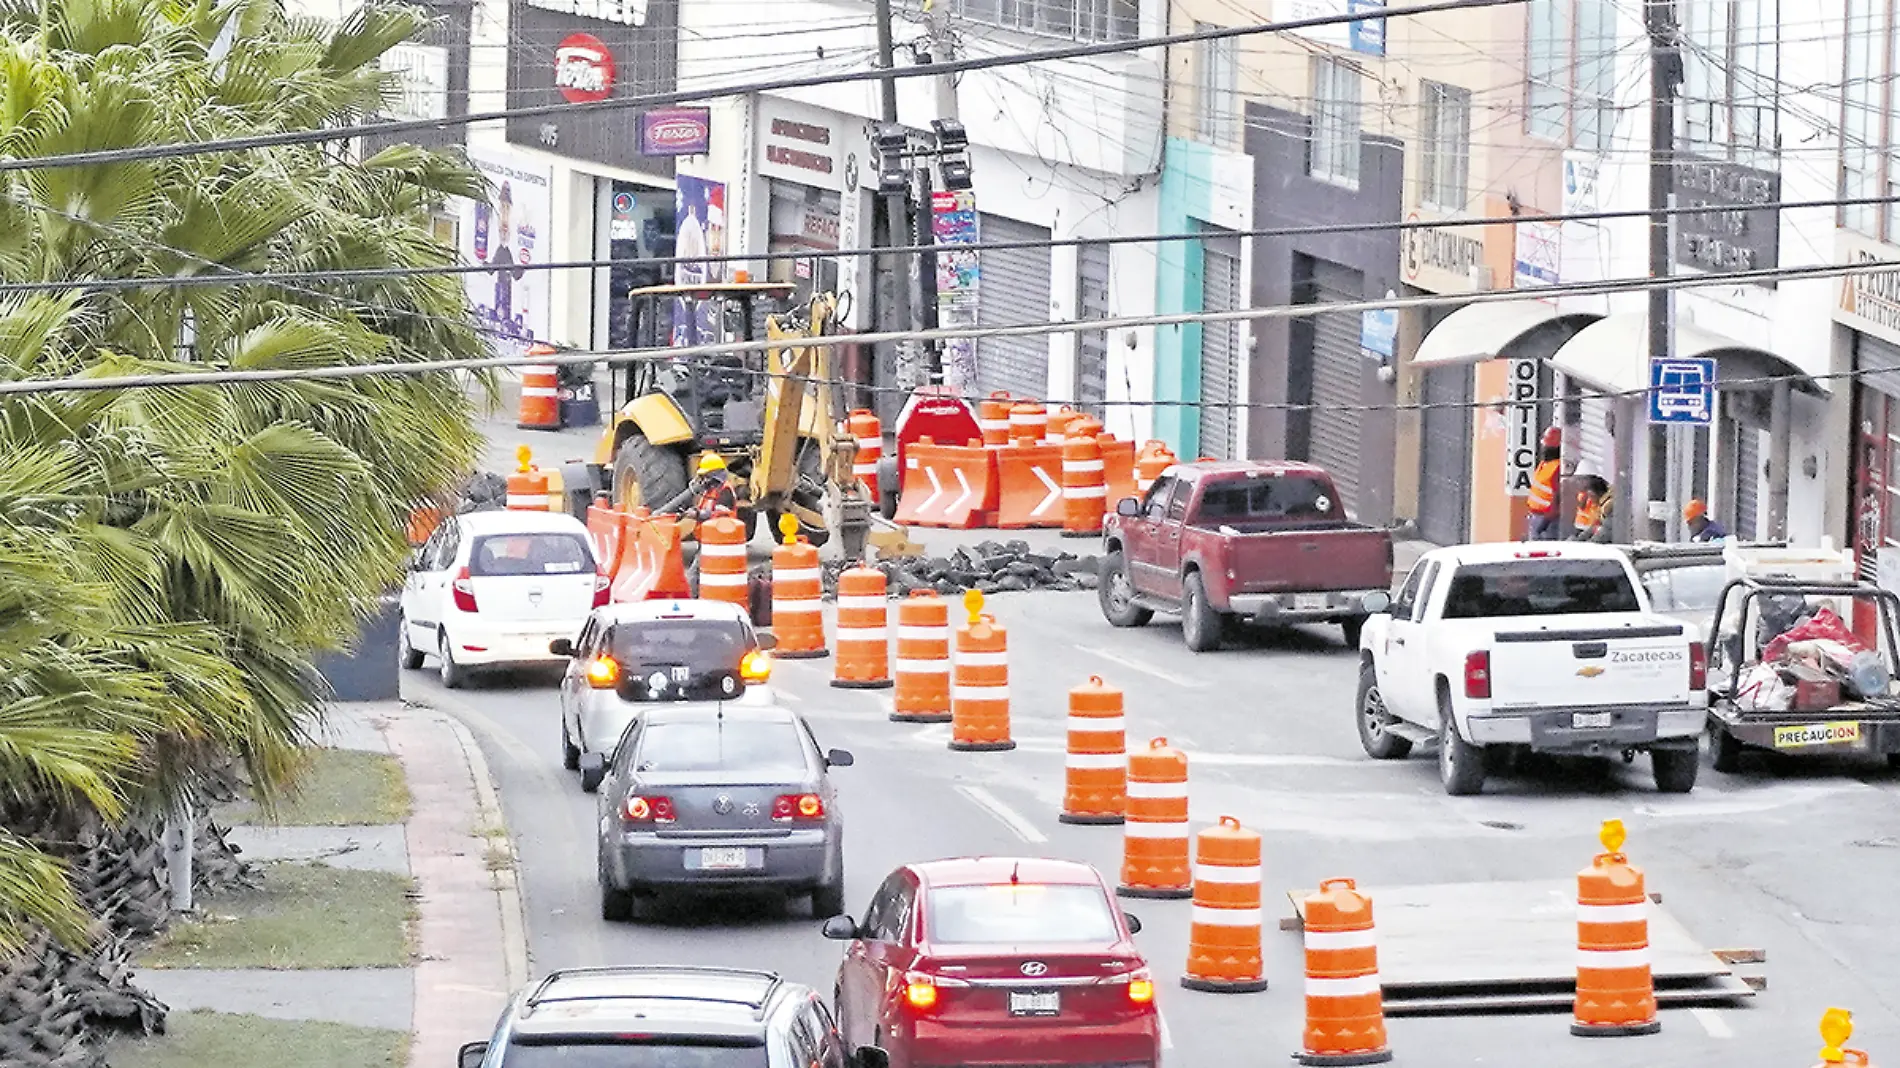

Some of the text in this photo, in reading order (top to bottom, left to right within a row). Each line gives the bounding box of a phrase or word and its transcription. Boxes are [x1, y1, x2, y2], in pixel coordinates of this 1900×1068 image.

[1513, 361, 1535, 490] OPTICA
[1611, 650, 1683, 663] Zacatecas
[1778, 726, 1856, 743] PRECAUCION
